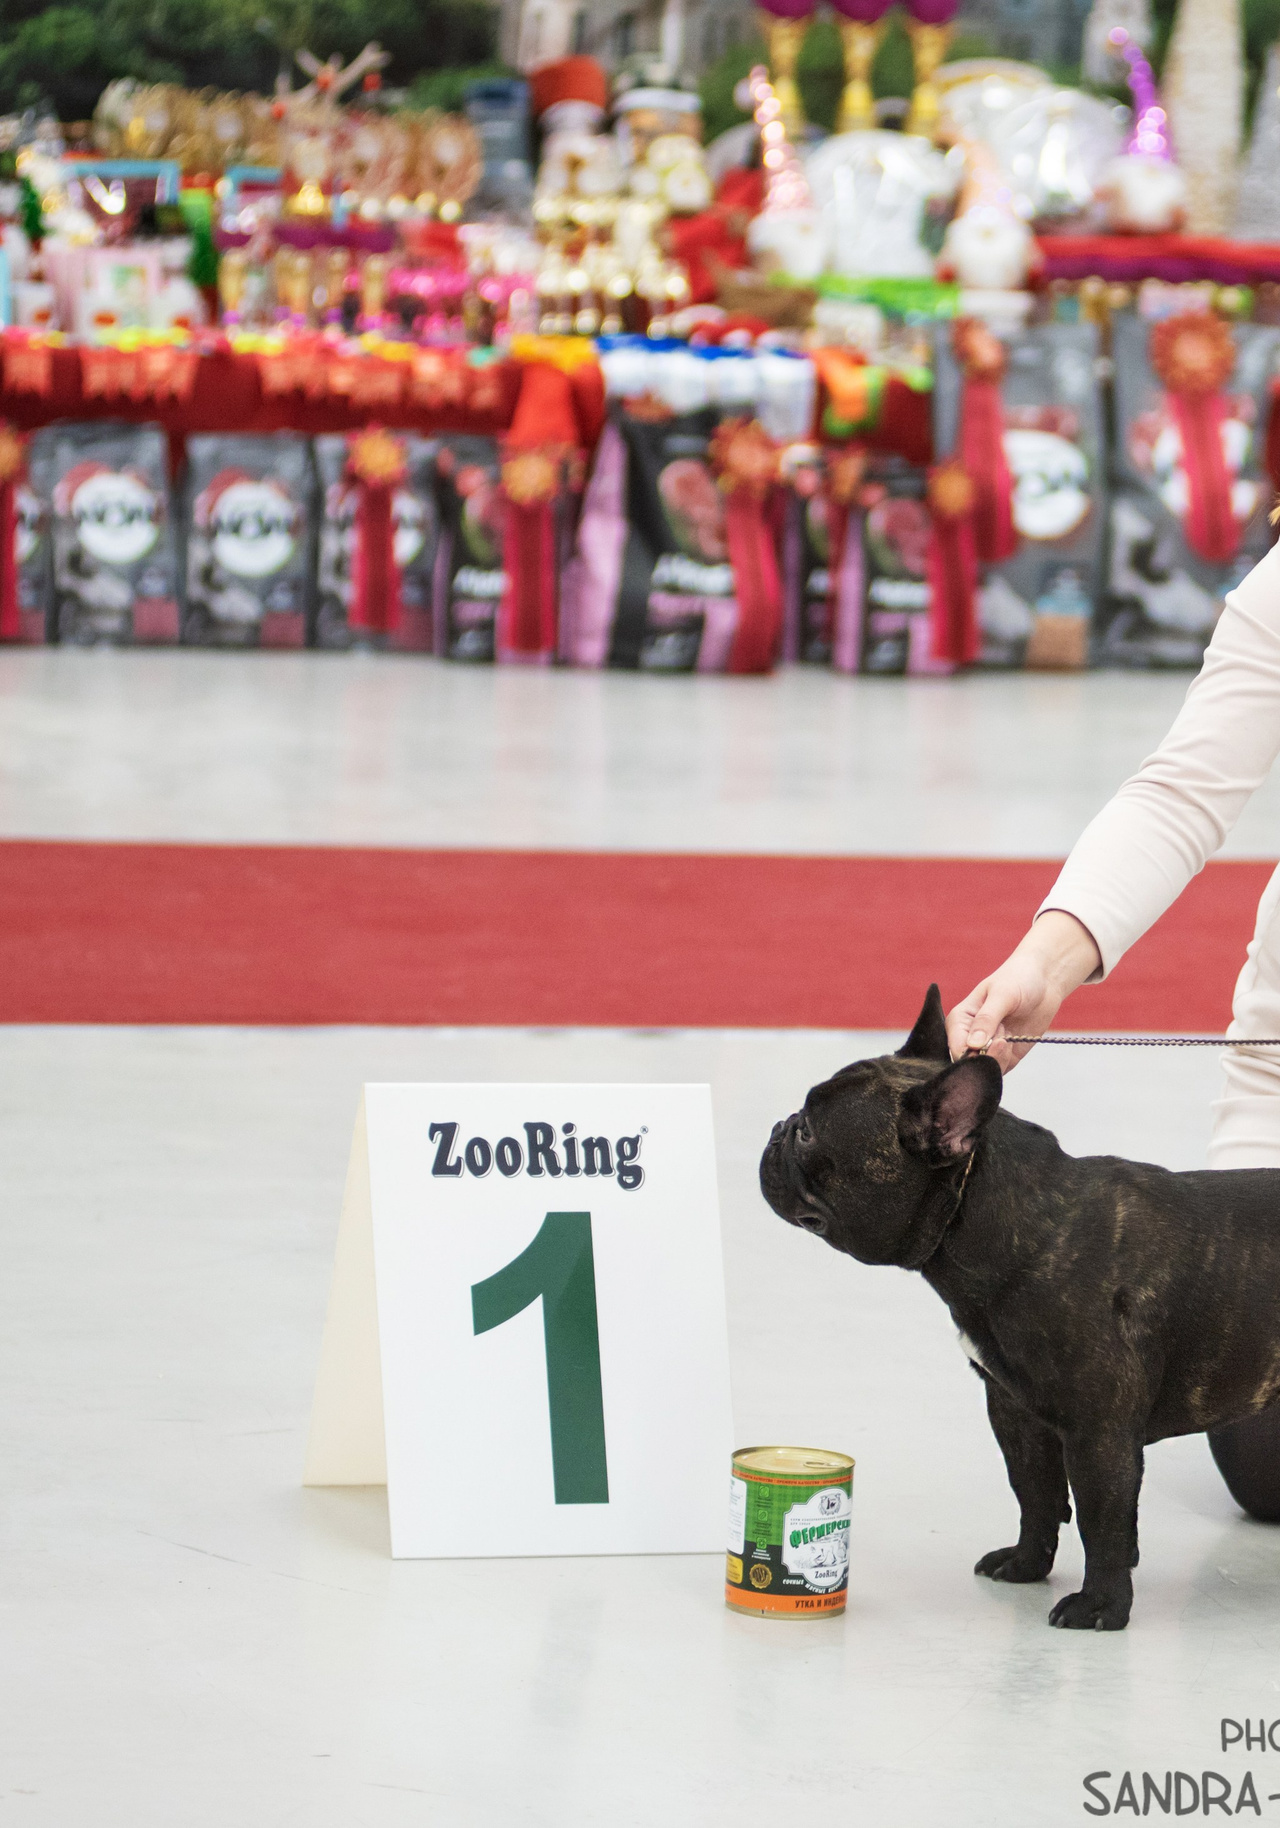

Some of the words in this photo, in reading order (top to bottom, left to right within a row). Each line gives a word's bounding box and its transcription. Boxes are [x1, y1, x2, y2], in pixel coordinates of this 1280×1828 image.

[428, 1121, 645, 1191] ZooRing
[470, 1211, 610, 1505] 1
[814, 1569, 838, 1579] ZooRing
[795, 1599, 815, 1609] УТКА
[816, 1599, 822, 1608] И
